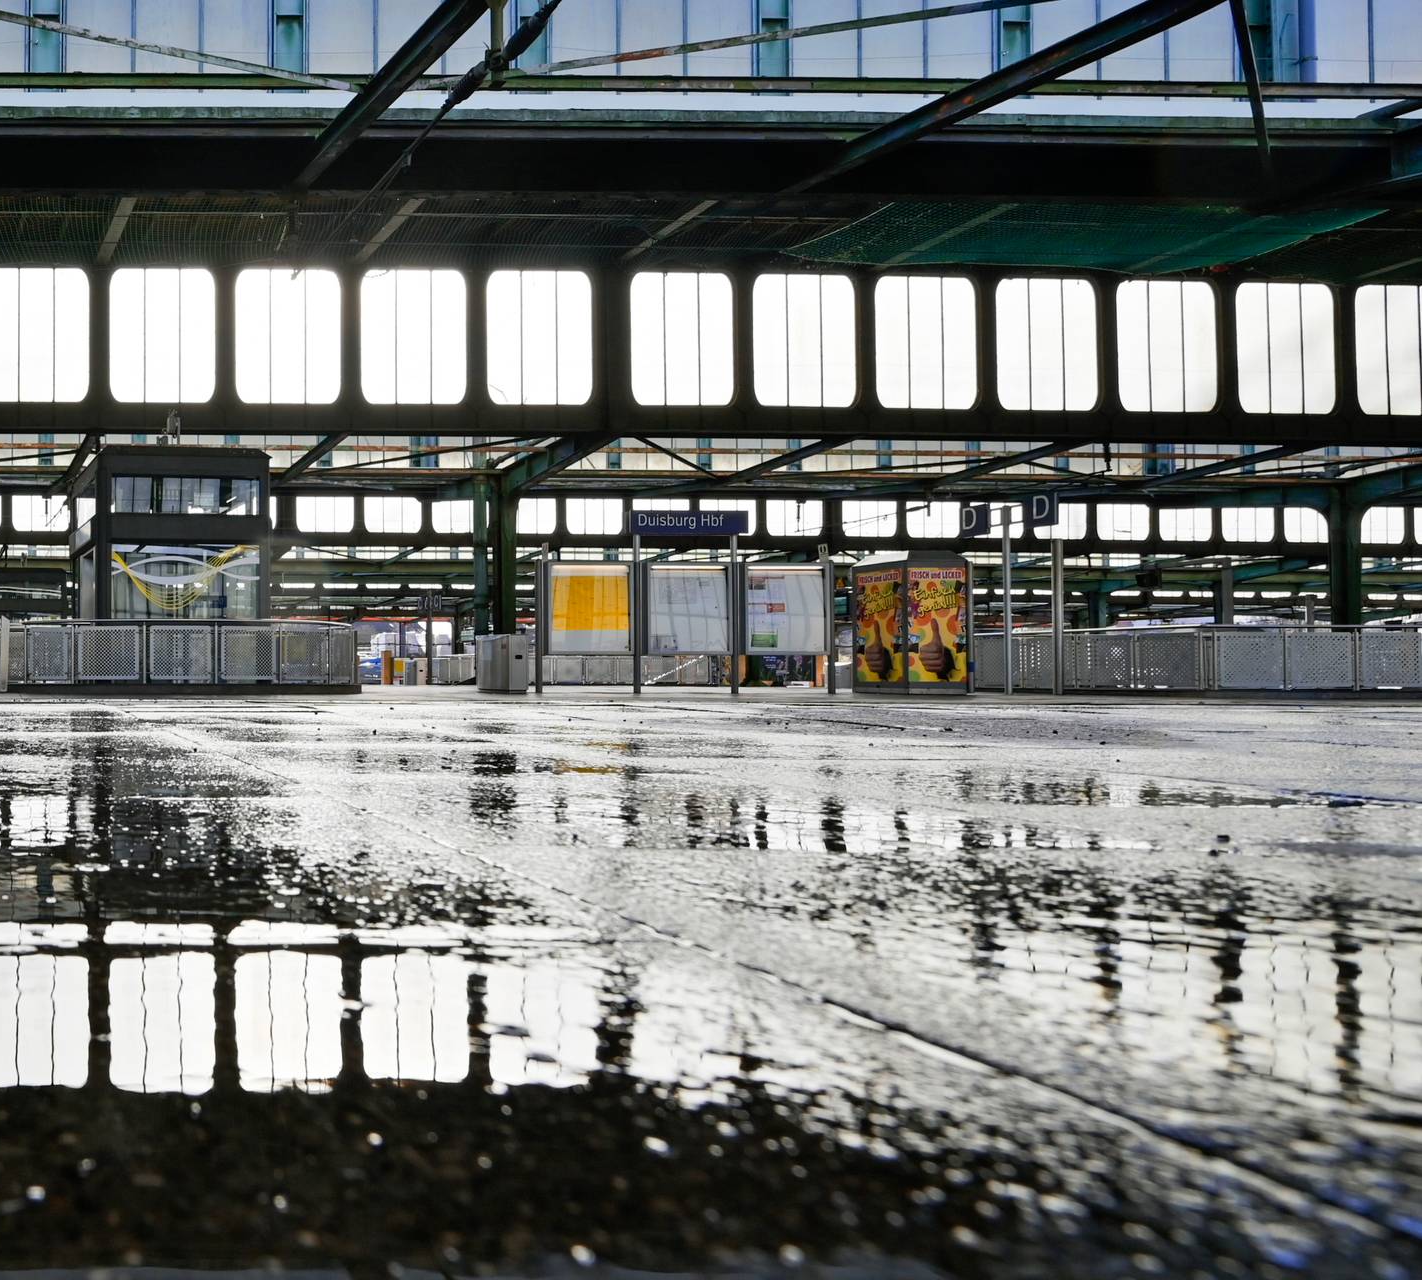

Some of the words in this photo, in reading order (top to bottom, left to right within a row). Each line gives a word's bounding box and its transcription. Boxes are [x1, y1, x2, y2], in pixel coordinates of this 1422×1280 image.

[962, 507, 977, 530] D
[1032, 494, 1050, 520] D
[638, 513, 697, 530] Duisburg
[701, 513, 724, 527] Hbf
